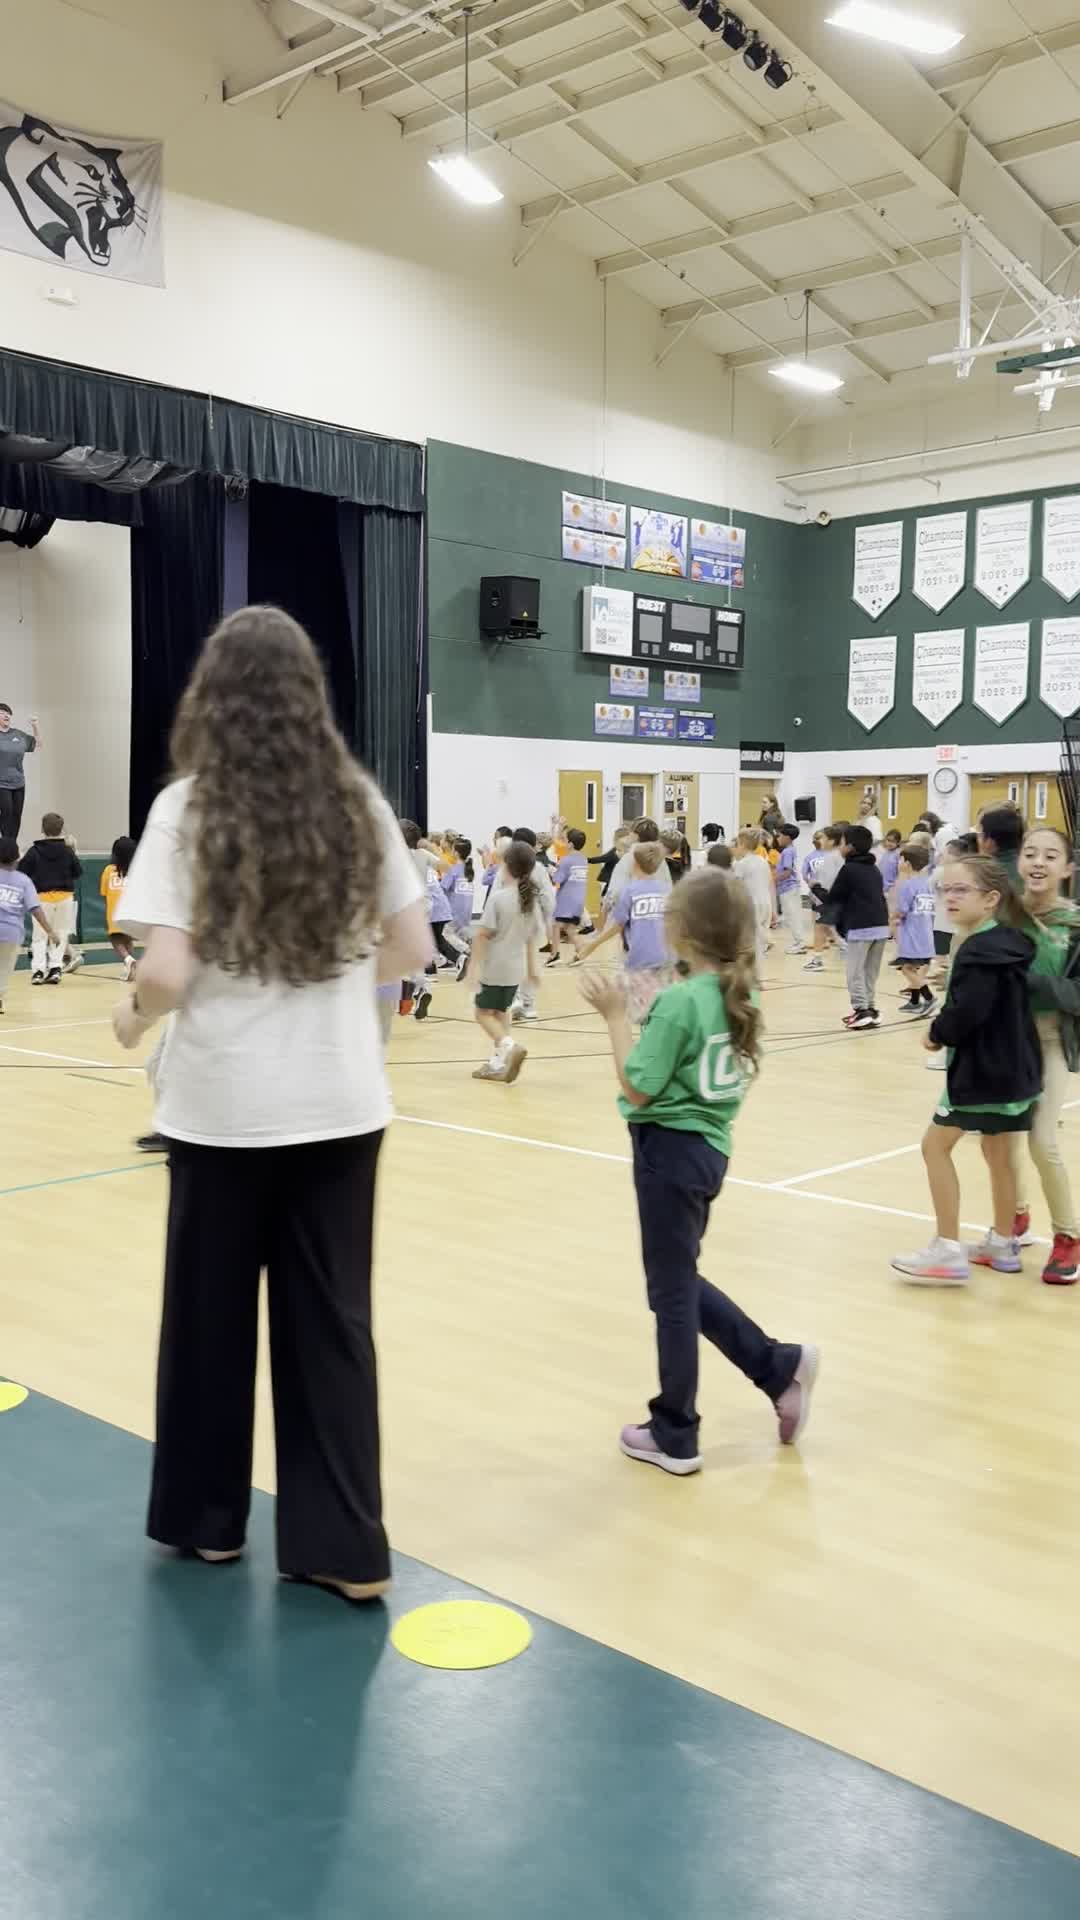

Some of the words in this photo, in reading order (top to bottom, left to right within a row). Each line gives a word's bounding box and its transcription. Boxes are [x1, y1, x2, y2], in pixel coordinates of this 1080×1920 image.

[981, 520, 1028, 537] Champions
[919, 529, 964, 546] Champions
[857, 538, 900, 553] Champions
[916, 646, 961, 660] Champions
[979, 639, 1027, 654] Champions
[851, 650, 894, 664] Champions
[852, 695, 889, 706] 2021-22
